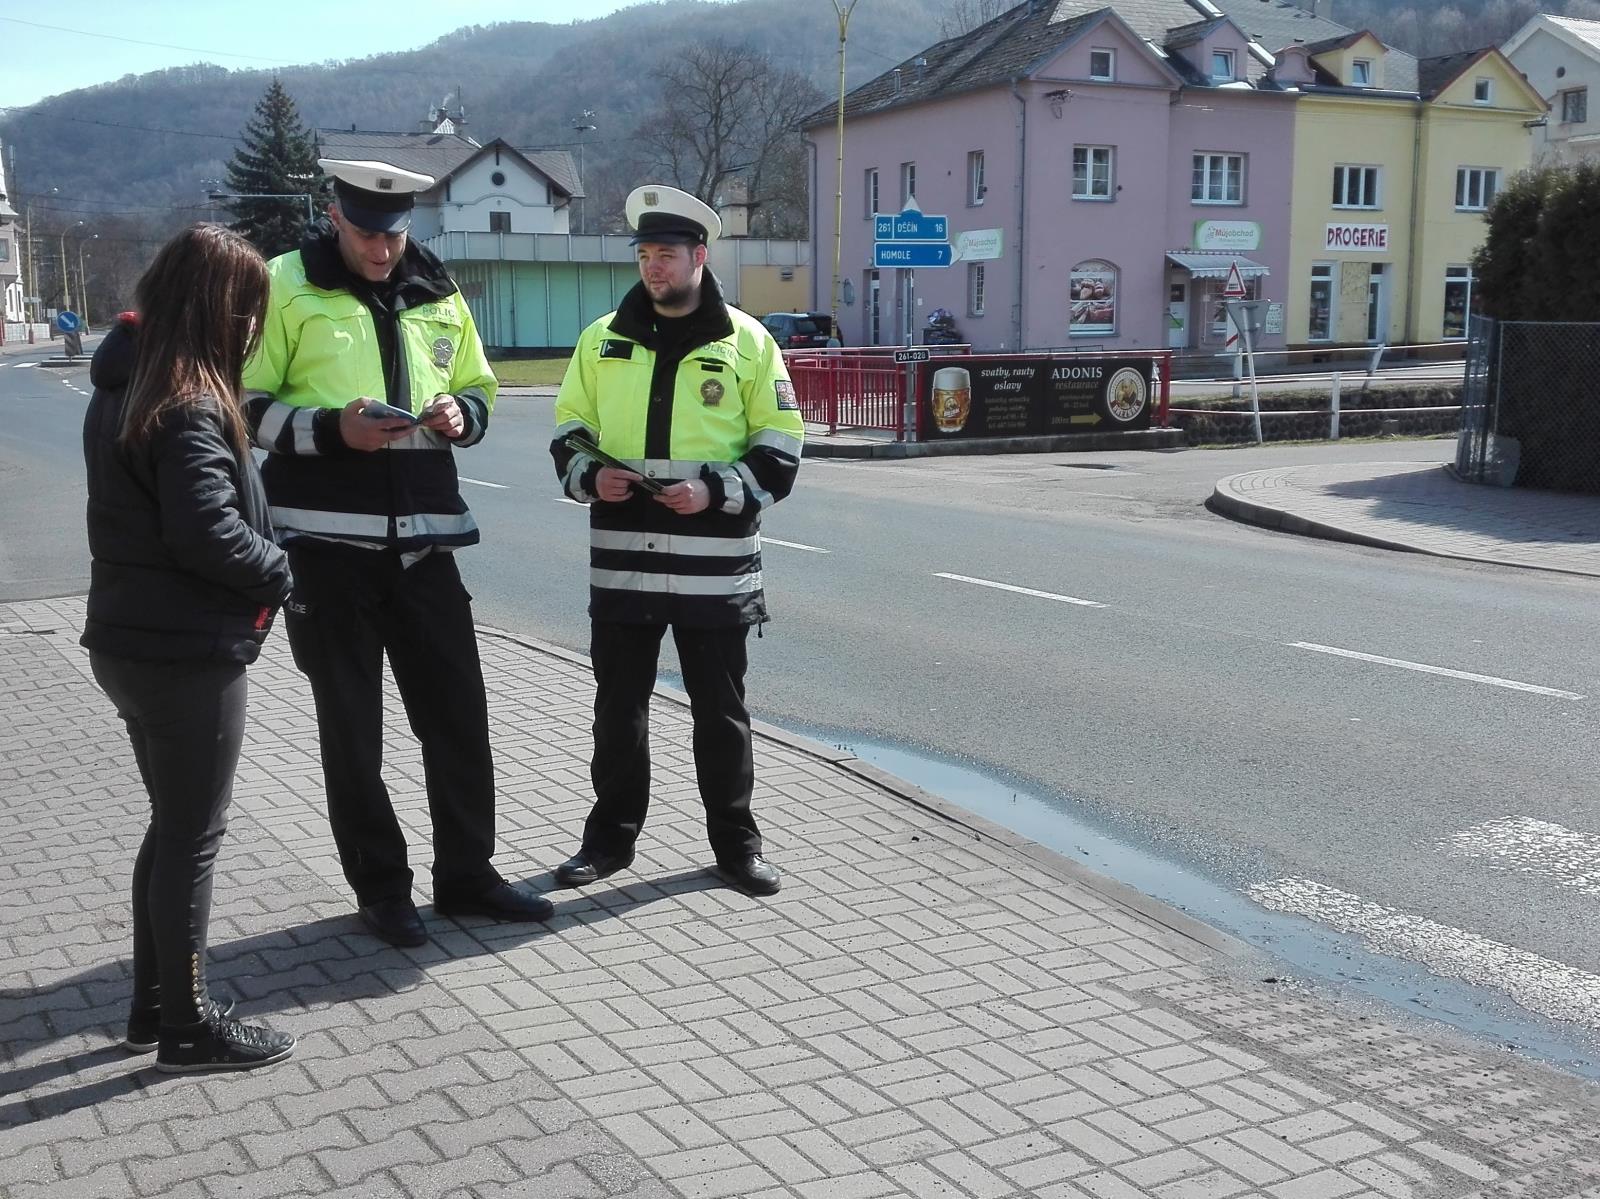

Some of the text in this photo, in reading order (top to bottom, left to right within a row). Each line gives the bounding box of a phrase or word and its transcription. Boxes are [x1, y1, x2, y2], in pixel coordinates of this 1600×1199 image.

[878, 221, 944, 233] 261 DĚČÍN 16
[1327, 226, 1387, 247] DROGERIE
[881, 250, 944, 260] HOMOLE 7
[981, 366, 1035, 380] svatby, rauty
[1051, 367, 1103, 379] ADONIS
[994, 380, 1022, 392] oslavy
